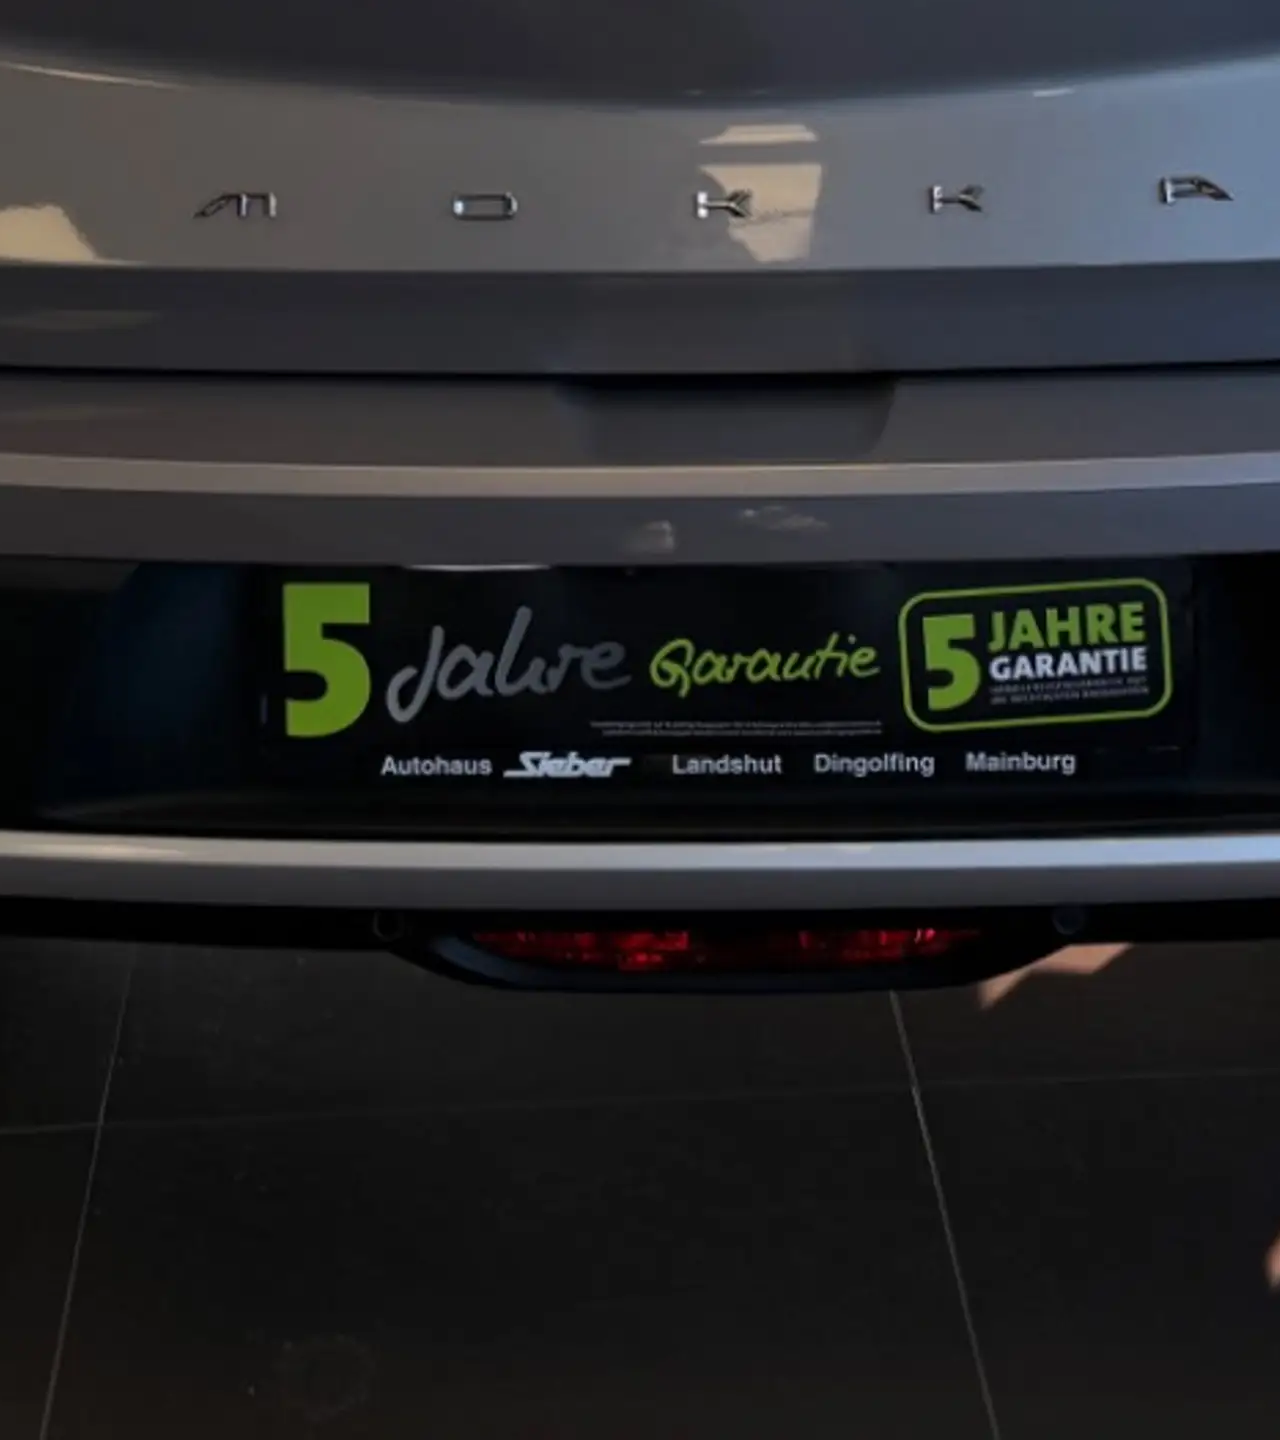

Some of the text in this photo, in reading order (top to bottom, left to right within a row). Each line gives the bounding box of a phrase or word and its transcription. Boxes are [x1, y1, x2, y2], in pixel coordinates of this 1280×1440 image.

[193, 174, 1234, 219] MOKKA
[988, 602, 1146, 653] JAHRE
[282, 582, 881, 738] 5 Jahre Garantie
[922, 613, 981, 711] 5
[988, 645, 1148, 681] GARANTIE
[380, 750, 1077, 778] Autohaus Sieber Landshut Dingolfing Mainburg
